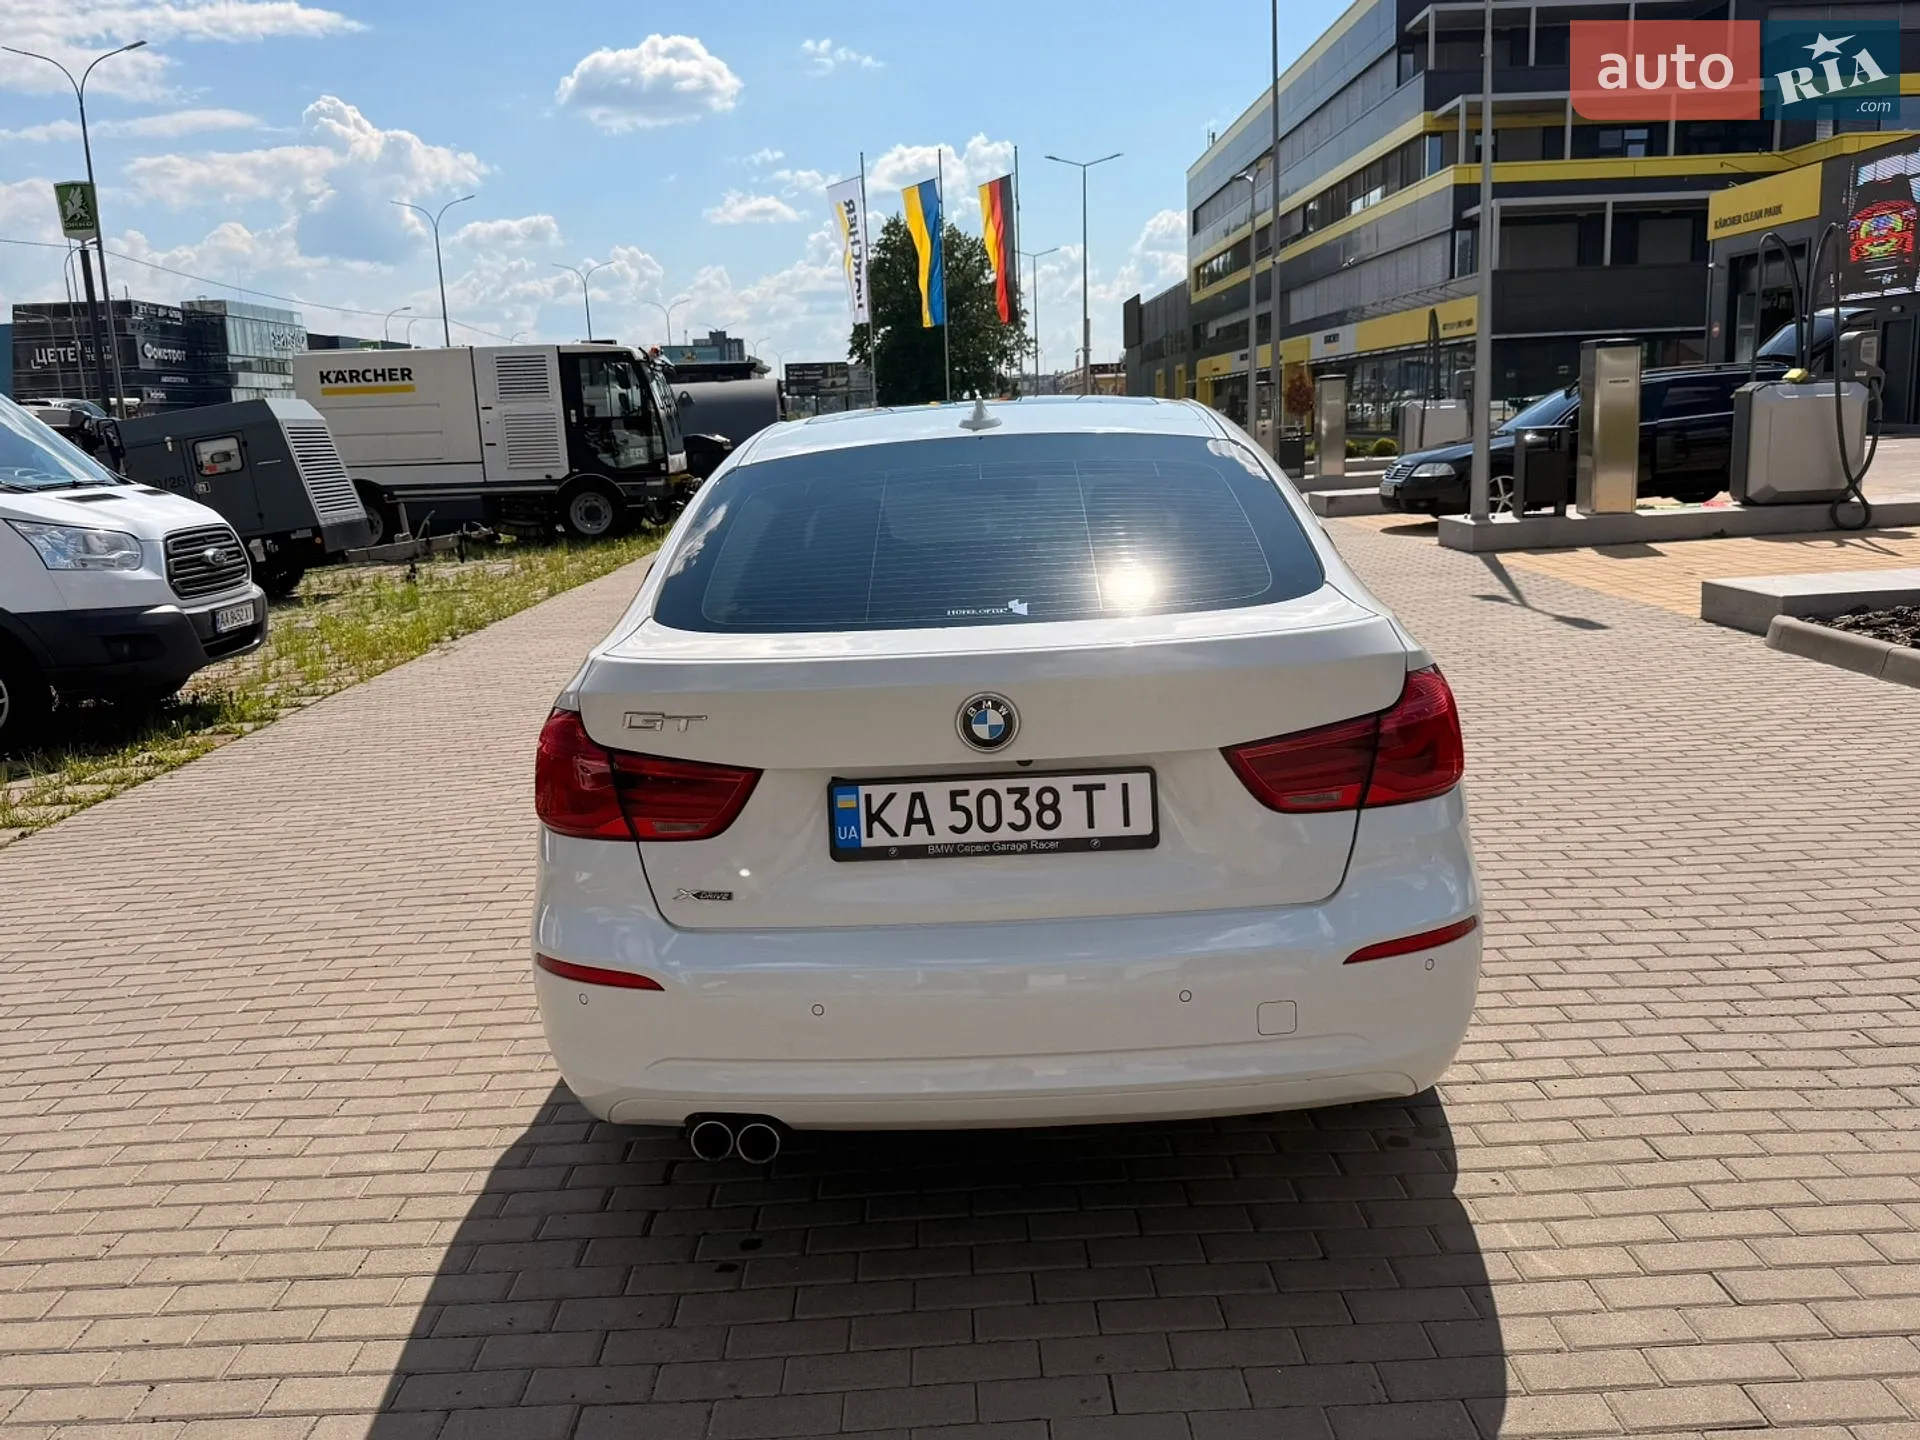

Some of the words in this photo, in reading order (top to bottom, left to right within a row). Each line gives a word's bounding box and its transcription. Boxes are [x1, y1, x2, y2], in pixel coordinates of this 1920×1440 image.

[319, 367, 414, 385] KÄRCHER
[966, 700, 1009, 716] BMW
[622, 711, 708, 733] GT
[864, 791, 936, 839] KA
[947, 786, 1063, 835] 5038
[1072, 782, 1131, 830] TI
[837, 826, 859, 840] UA
[928, 844, 955, 855] BMW
[992, 840, 1028, 852] Garage
[1030, 839, 1060, 850] Racer
